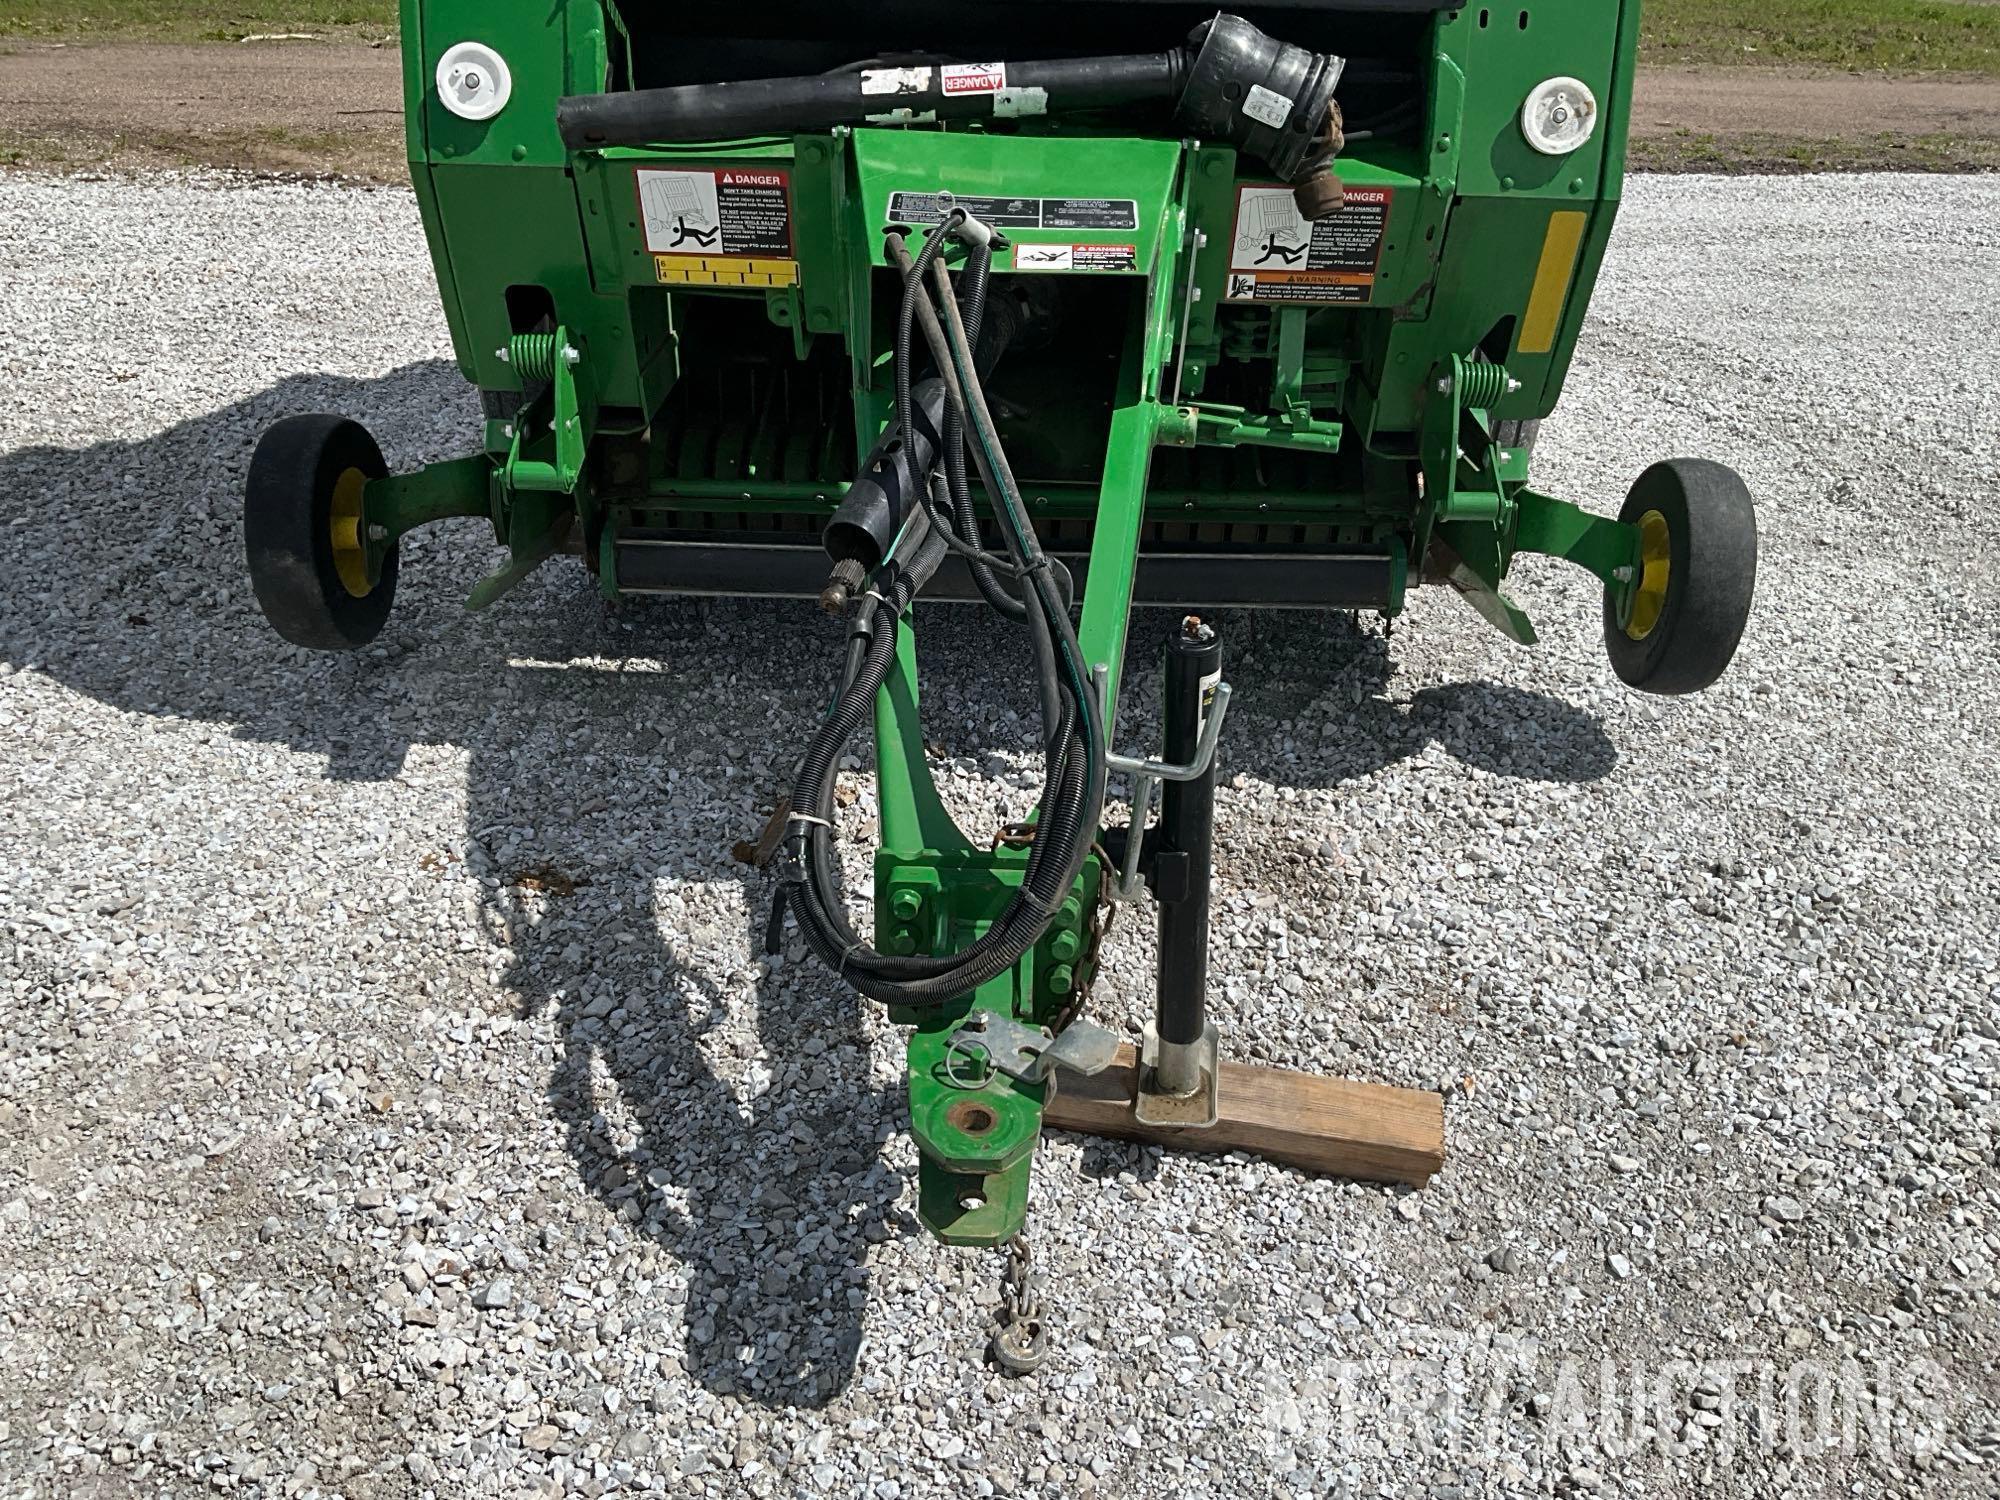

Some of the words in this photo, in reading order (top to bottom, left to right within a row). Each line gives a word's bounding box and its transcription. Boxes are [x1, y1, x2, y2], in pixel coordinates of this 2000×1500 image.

[946, 77, 988, 89] DANGER
[735, 175, 781, 185] DANGER
[1295, 276, 1341, 284] WARNING
